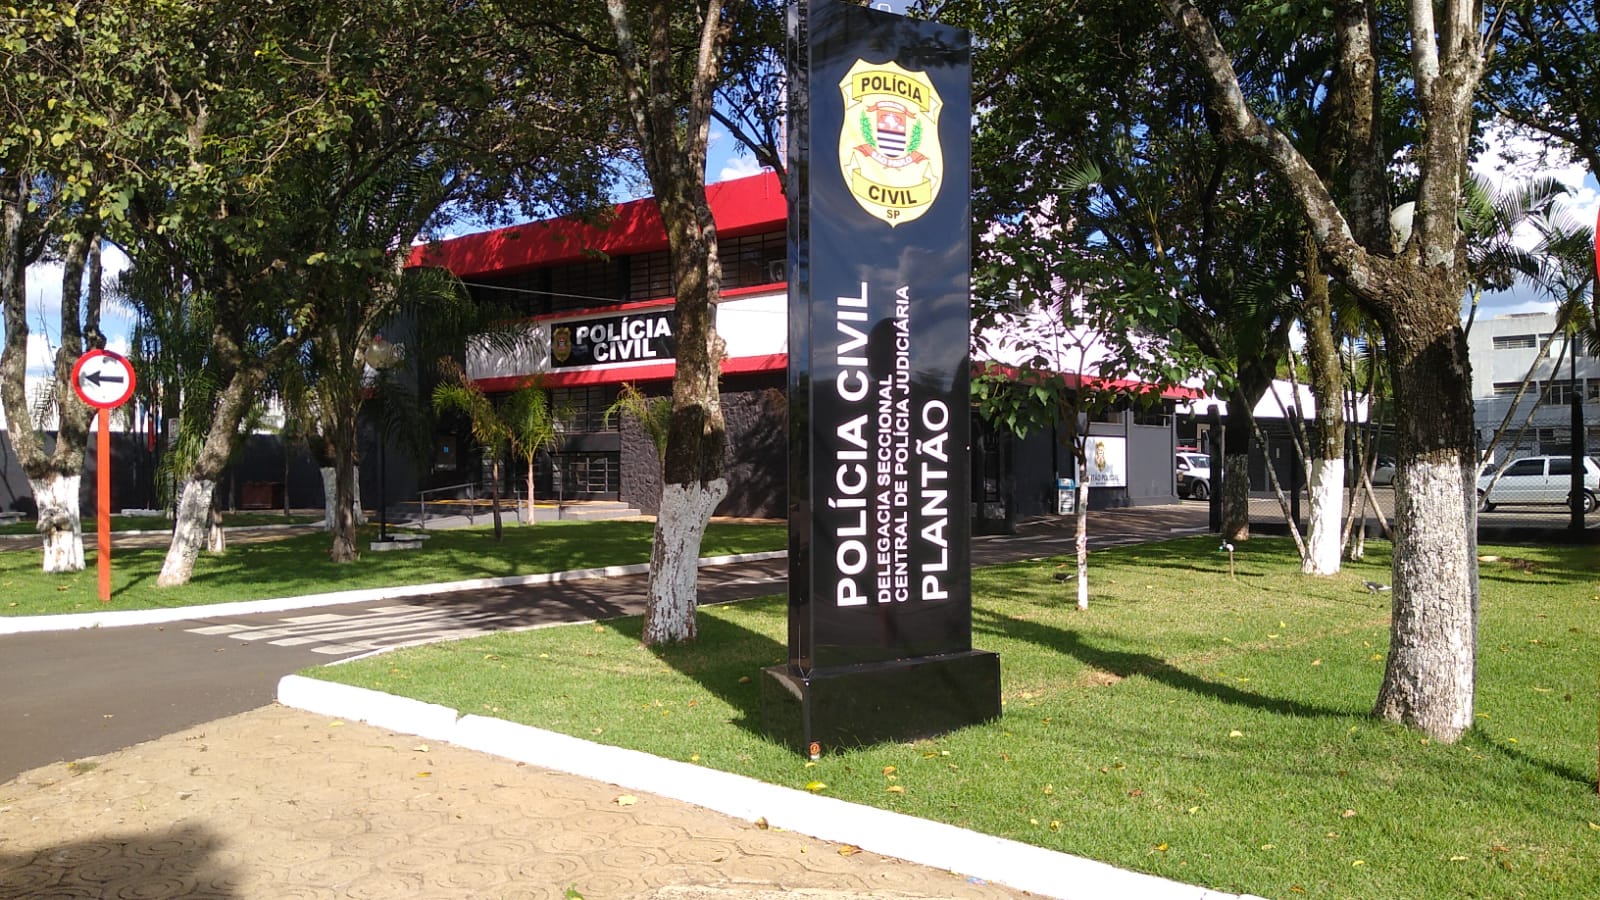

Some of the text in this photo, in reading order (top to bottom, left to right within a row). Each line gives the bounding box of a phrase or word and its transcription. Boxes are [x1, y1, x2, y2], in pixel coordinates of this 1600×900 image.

[861, 75, 922, 103] POLÍCIA
[868, 185, 917, 205] CIVIL
[886, 209, 900, 219] SP
[576, 317, 672, 345] POLÍCIA
[593, 338, 657, 362] CIVIL
[828, 282, 869, 606] POLÍCIA CIVIL
[893, 285, 910, 602] CENTRAL DE POLÍCIA JUDICIÁRIA
[877, 374, 892, 603] DELEGACIA SECCIONAL
[915, 400, 949, 600] PLANTÃO
